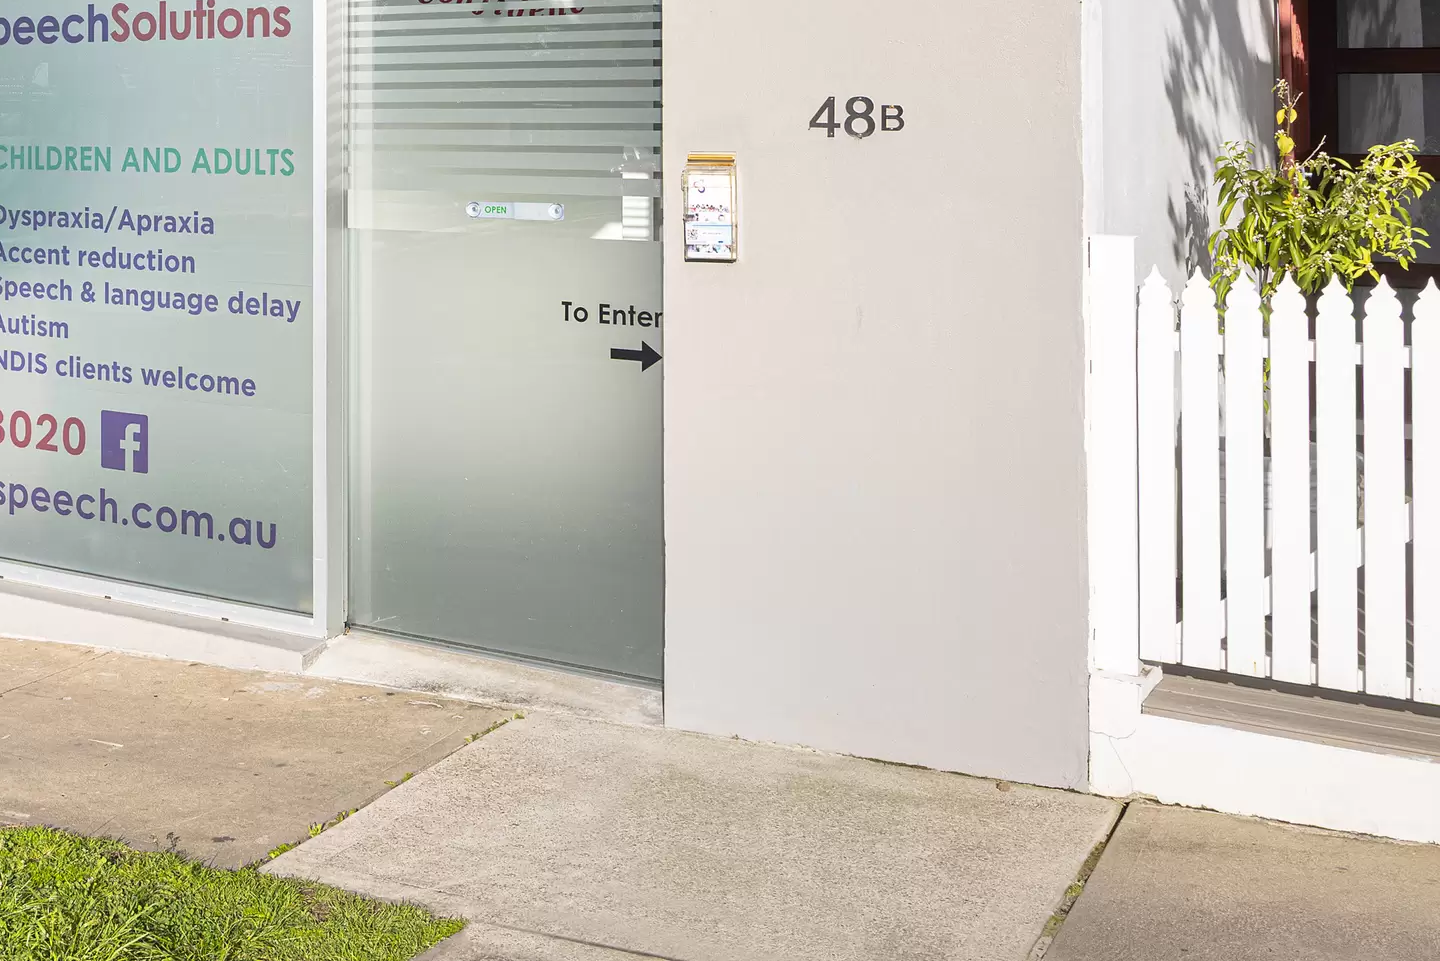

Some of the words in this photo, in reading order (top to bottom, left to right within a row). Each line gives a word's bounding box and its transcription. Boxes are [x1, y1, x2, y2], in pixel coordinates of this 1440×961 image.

[121, 147, 182, 173] AND
[191, 147, 295, 177] ADULTS
[484, 206, 507, 214] OPEN
[78, 247, 195, 273] reduction
[80, 281, 96, 303] &
[104, 282, 218, 315] language
[227, 290, 301, 323] delay
[561, 301, 588, 322] To
[599, 303, 663, 328] Enter
[55, 355, 133, 383] clients
[141, 366, 256, 397] welcome
